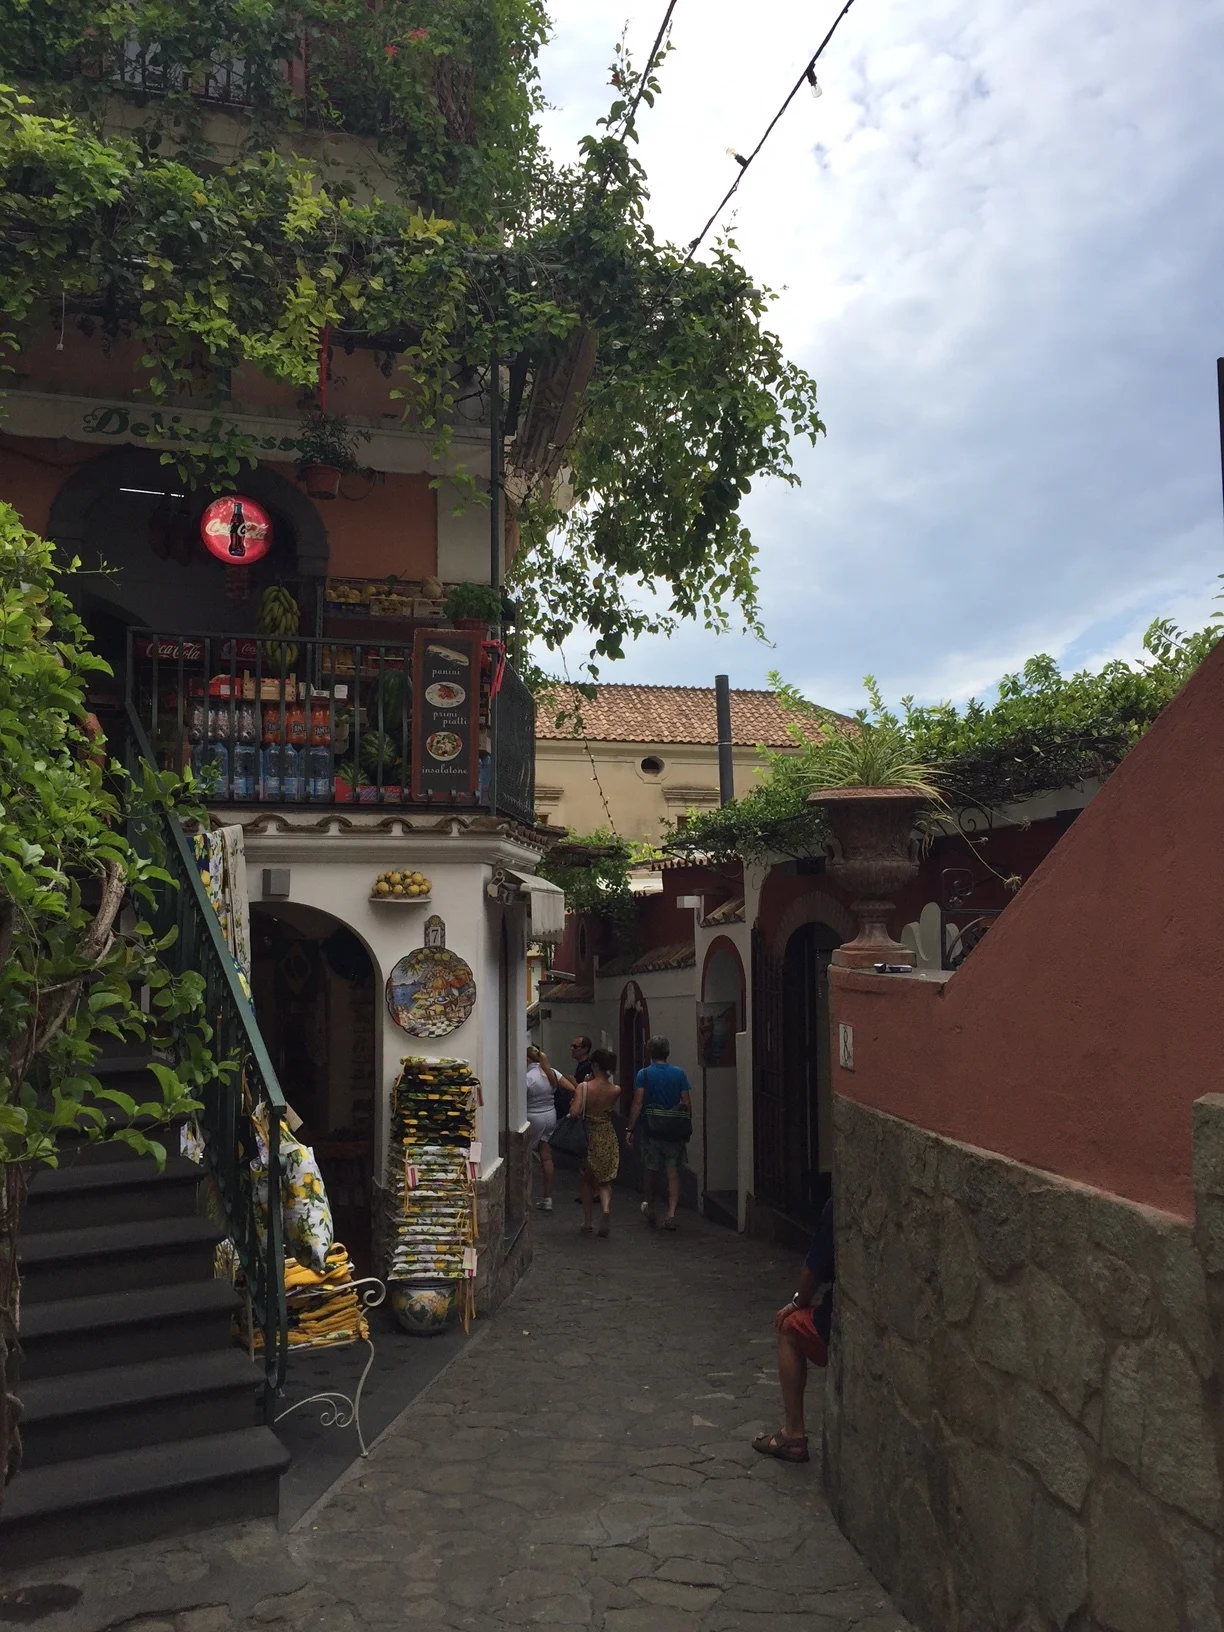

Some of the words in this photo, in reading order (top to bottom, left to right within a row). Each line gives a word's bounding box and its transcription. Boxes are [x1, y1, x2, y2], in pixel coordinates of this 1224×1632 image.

[146, 642, 200, 660] Cca-Cola
[432, 668, 460, 678] panini
[433, 710, 459, 721] primi
[442, 716, 468, 728] piatti
[291, 724, 306, 734] FANT
[421, 763, 469, 775] insalatone
[431, 929, 439, 944] 7
[843, 1029, 850, 1061] 8
